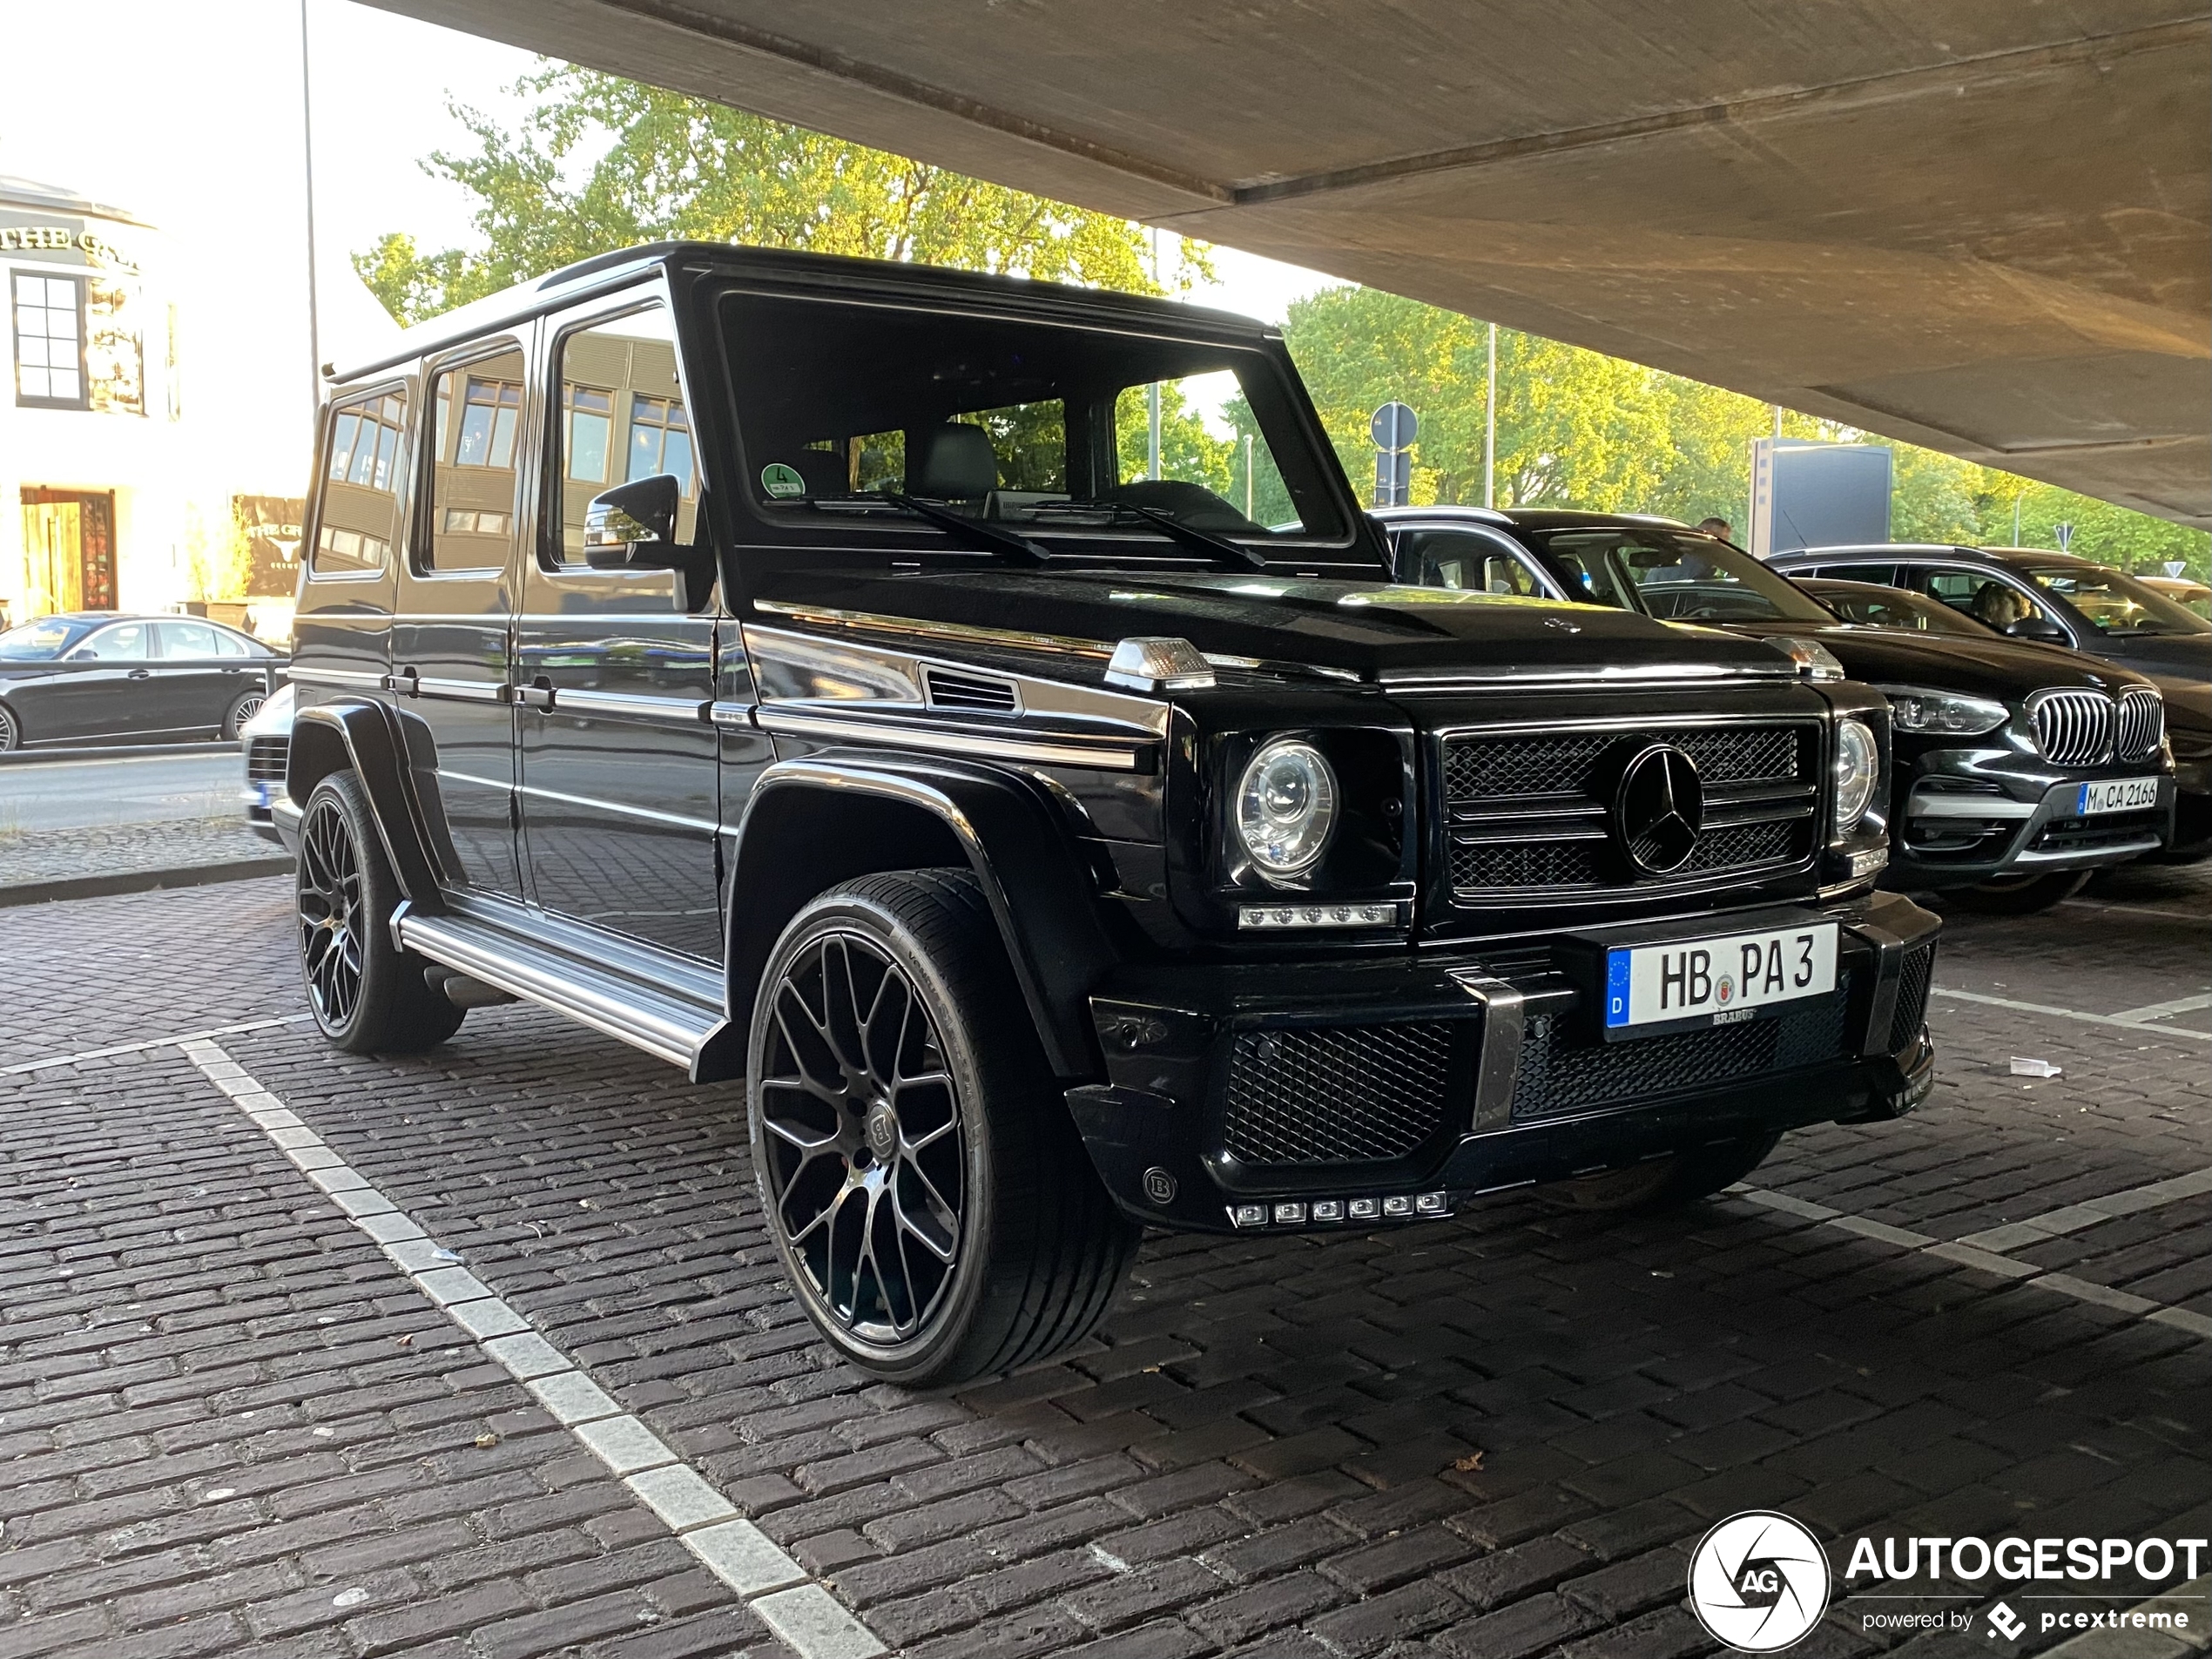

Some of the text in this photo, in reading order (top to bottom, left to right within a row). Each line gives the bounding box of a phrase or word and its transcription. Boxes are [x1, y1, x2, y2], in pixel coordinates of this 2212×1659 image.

[0, 227, 71, 249] THE
[777, 466, 787, 482] 4
[2087, 781, 2155, 810] M CA 2166
[1661, 934, 1814, 1009] HB PA 3
[1612, 997, 1622, 1014] D
[1712, 1008, 1755, 1026] BRABUS
